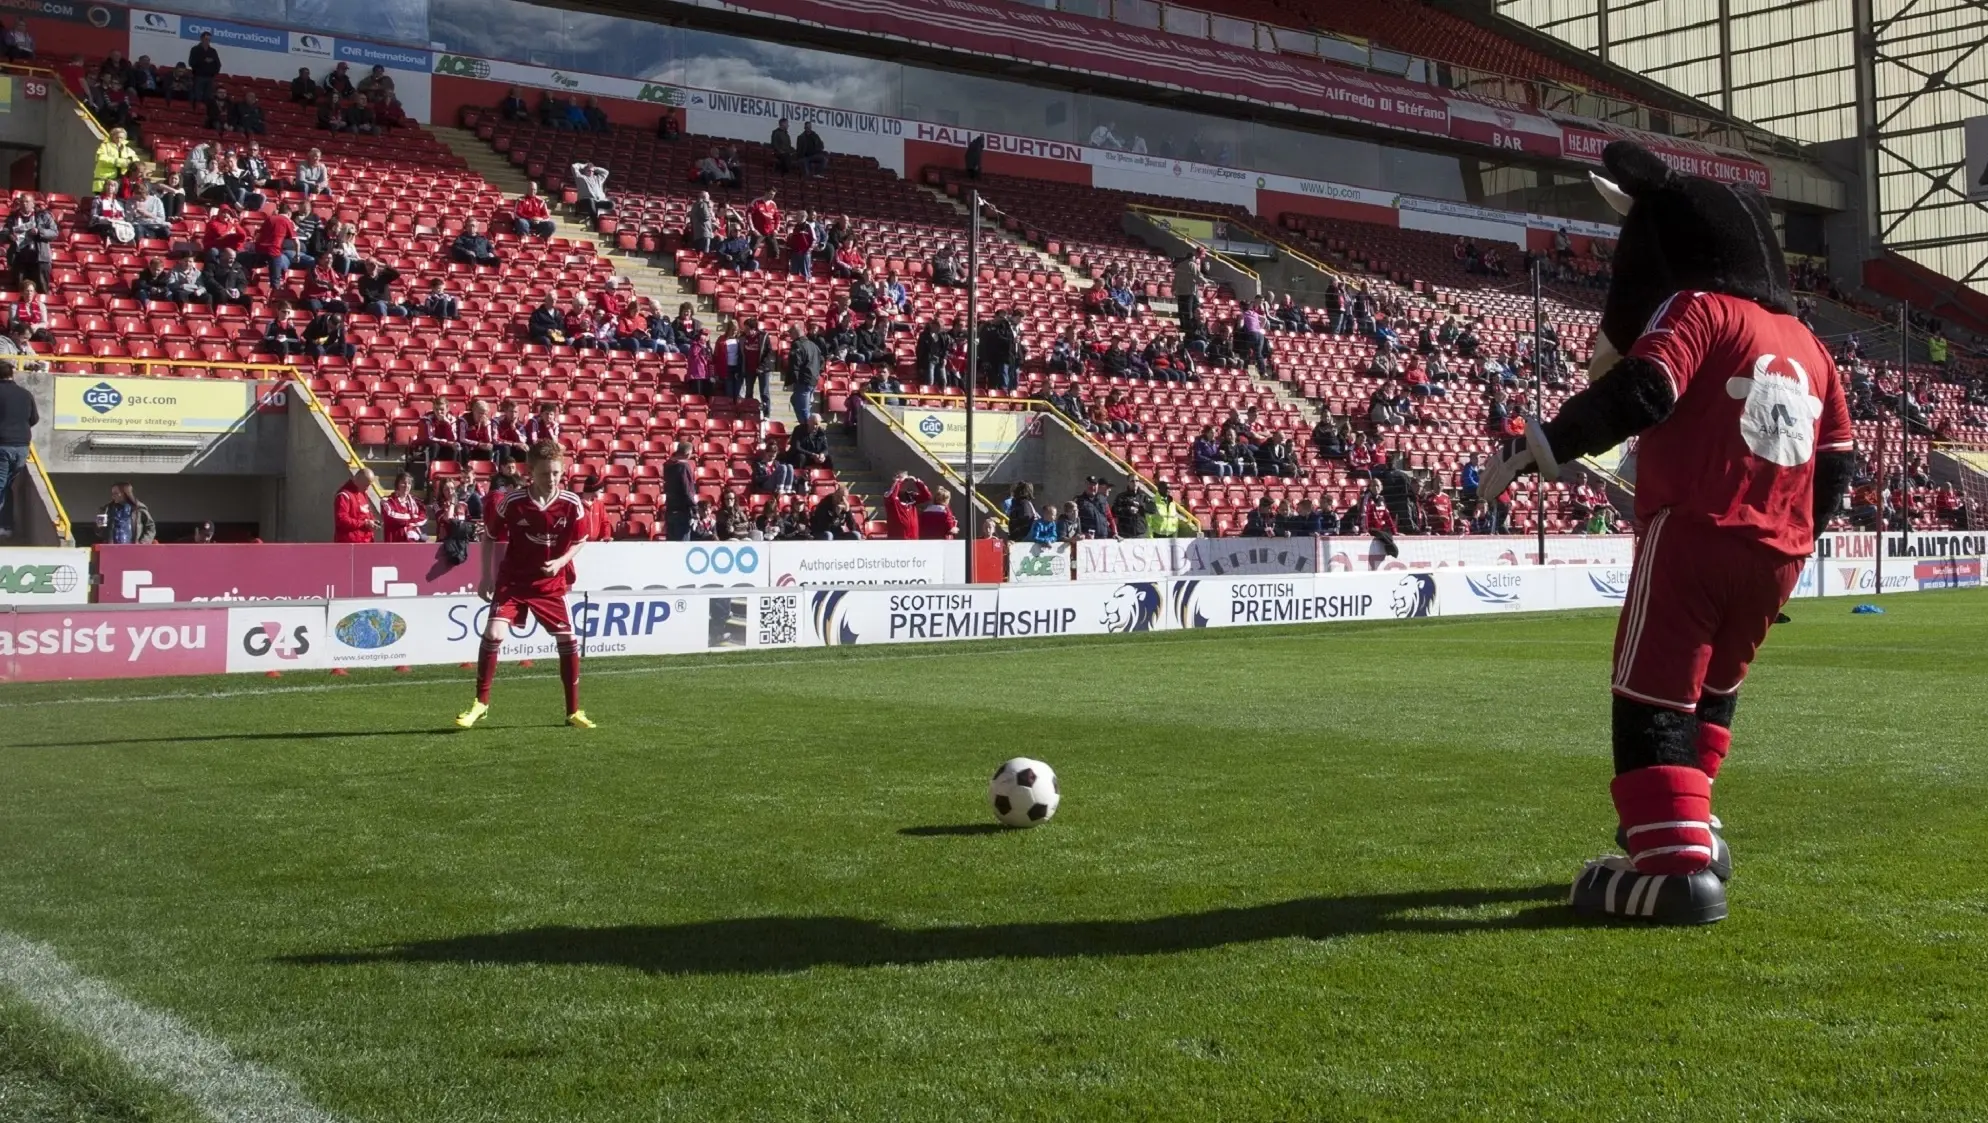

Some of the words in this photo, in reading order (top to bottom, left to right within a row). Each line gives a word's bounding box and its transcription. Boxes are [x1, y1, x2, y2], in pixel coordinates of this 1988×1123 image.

[188, 24, 212, 35] CNR
[213, 26, 281, 46] International
[341, 46, 362, 57] CNR
[364, 48, 427, 65] International
[434, 54, 477, 78] ACE
[26, 82, 47, 97] 39
[636, 83, 675, 105] ACE
[1325, 86, 1375, 109] Alfredo
[1380, 95, 1393, 111] Di
[1396, 99, 1446, 120] Stéfano
[708, 93, 779, 119] UNIVERSAL
[782, 103, 853, 130] INSPECTION
[855, 114, 879, 136] (UK)
[882, 117, 902, 136] LTD
[1493, 134, 1522, 151] BAR
[1701, 161, 1713, 177] FC
[1714, 163, 1742, 181] SINCE
[1744, 168, 1767, 186] 1903
[1300, 181, 1361, 200] www.bp.com
[127, 394, 177, 409] gac.com
[80, 416, 123, 426] Delivering
[125, 417, 142, 427] your
[144, 417, 179, 427] strategy.
[1759, 424, 1804, 441] AMPLUS
[799, 557, 855, 571] Authorised
[857, 556, 910, 571] Distributor
[912, 557, 927, 568] for
[1016, 556, 1052, 577] ACE
[1084, 545, 1207, 574] MASADA
[1486, 572, 1522, 589] Saltire
[1231, 583, 1294, 599] SCOTTISH
[889, 594, 972, 611] SCOTTISH
[1231, 594, 1373, 623] PREMIERSHIP
[889, 607, 1077, 639] PREMIERSHIP
[0, 617, 115, 656] assist
[127, 624, 206, 662] you
[243, 621, 310, 660] G4S
[333, 651, 407, 662] www.scotgrip.com
